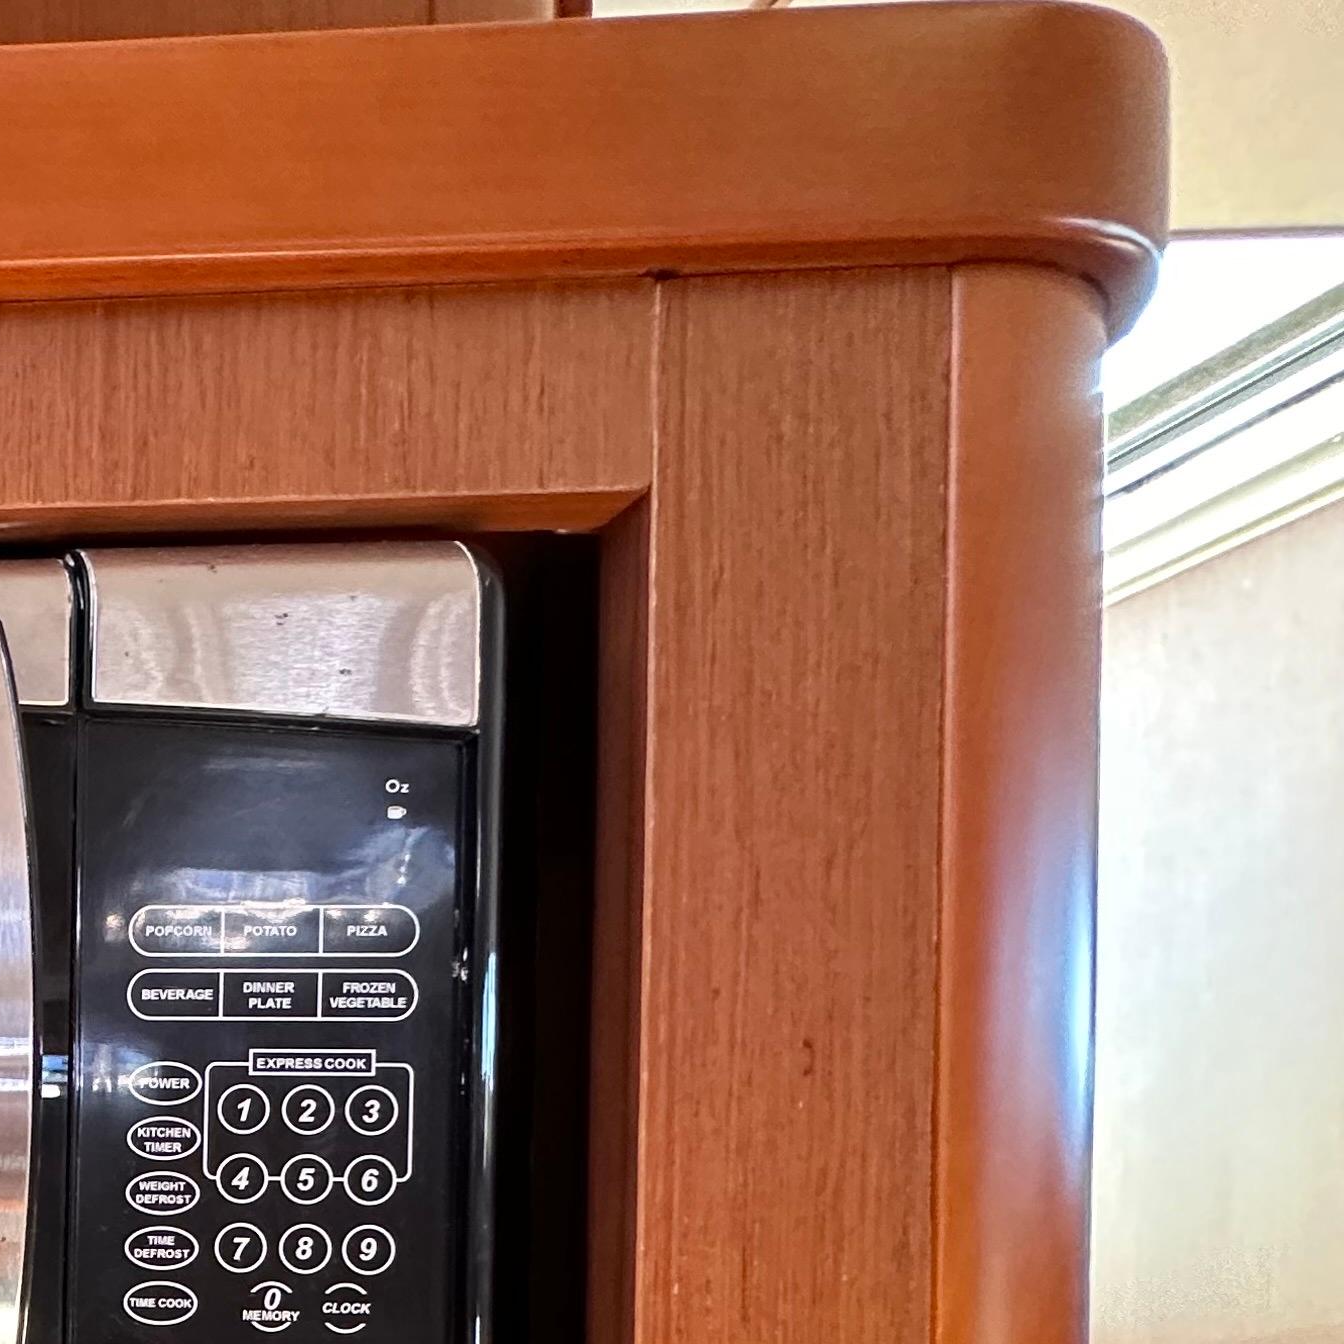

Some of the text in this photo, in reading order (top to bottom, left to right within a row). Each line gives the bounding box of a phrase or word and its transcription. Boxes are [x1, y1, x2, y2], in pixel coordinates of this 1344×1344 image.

[385, 779, 409, 793] Oz
[145, 925, 213, 937] POPCORN
[243, 925, 297, 937] POTATO
[346, 925, 388, 937] PIZZA
[242, 981, 295, 994] DINNER
[342, 982, 396, 994] FROZEN
[141, 988, 214, 1001] BEVERAGE
[248, 997, 292, 1009] PLATE
[329, 997, 407, 1009] VEGETABLE
[256, 1057, 367, 1071] EXPRESS COOK
[139, 1078, 190, 1090] POWER
[236, 1098, 252, 1122] 1
[298, 1099, 317, 1123] 2
[362, 1099, 380, 1124] 3
[136, 1127, 192, 1139] KITCHEN
[143, 1141, 182, 1153] TIMER
[231, 1166, 250, 1190] 4
[296, 1168, 315, 1191] 5
[361, 1168, 380, 1193] 6
[138, 1181, 186, 1192] WEIGHT
[135, 1194, 192, 1205] DEFROST
[146, 1235, 175, 1246] TIME
[133, 1248, 191, 1260] DEFROST
[231, 1237, 250, 1262] 7
[295, 1236, 314, 1260] 8
[359, 1237, 378, 1261] 9
[129, 1297, 193, 1309] TIME COOK
[263, 1288, 282, 1311] 0
[322, 1302, 371, 1315] CLOCK
[242, 1310, 300, 1322] MEMORY
